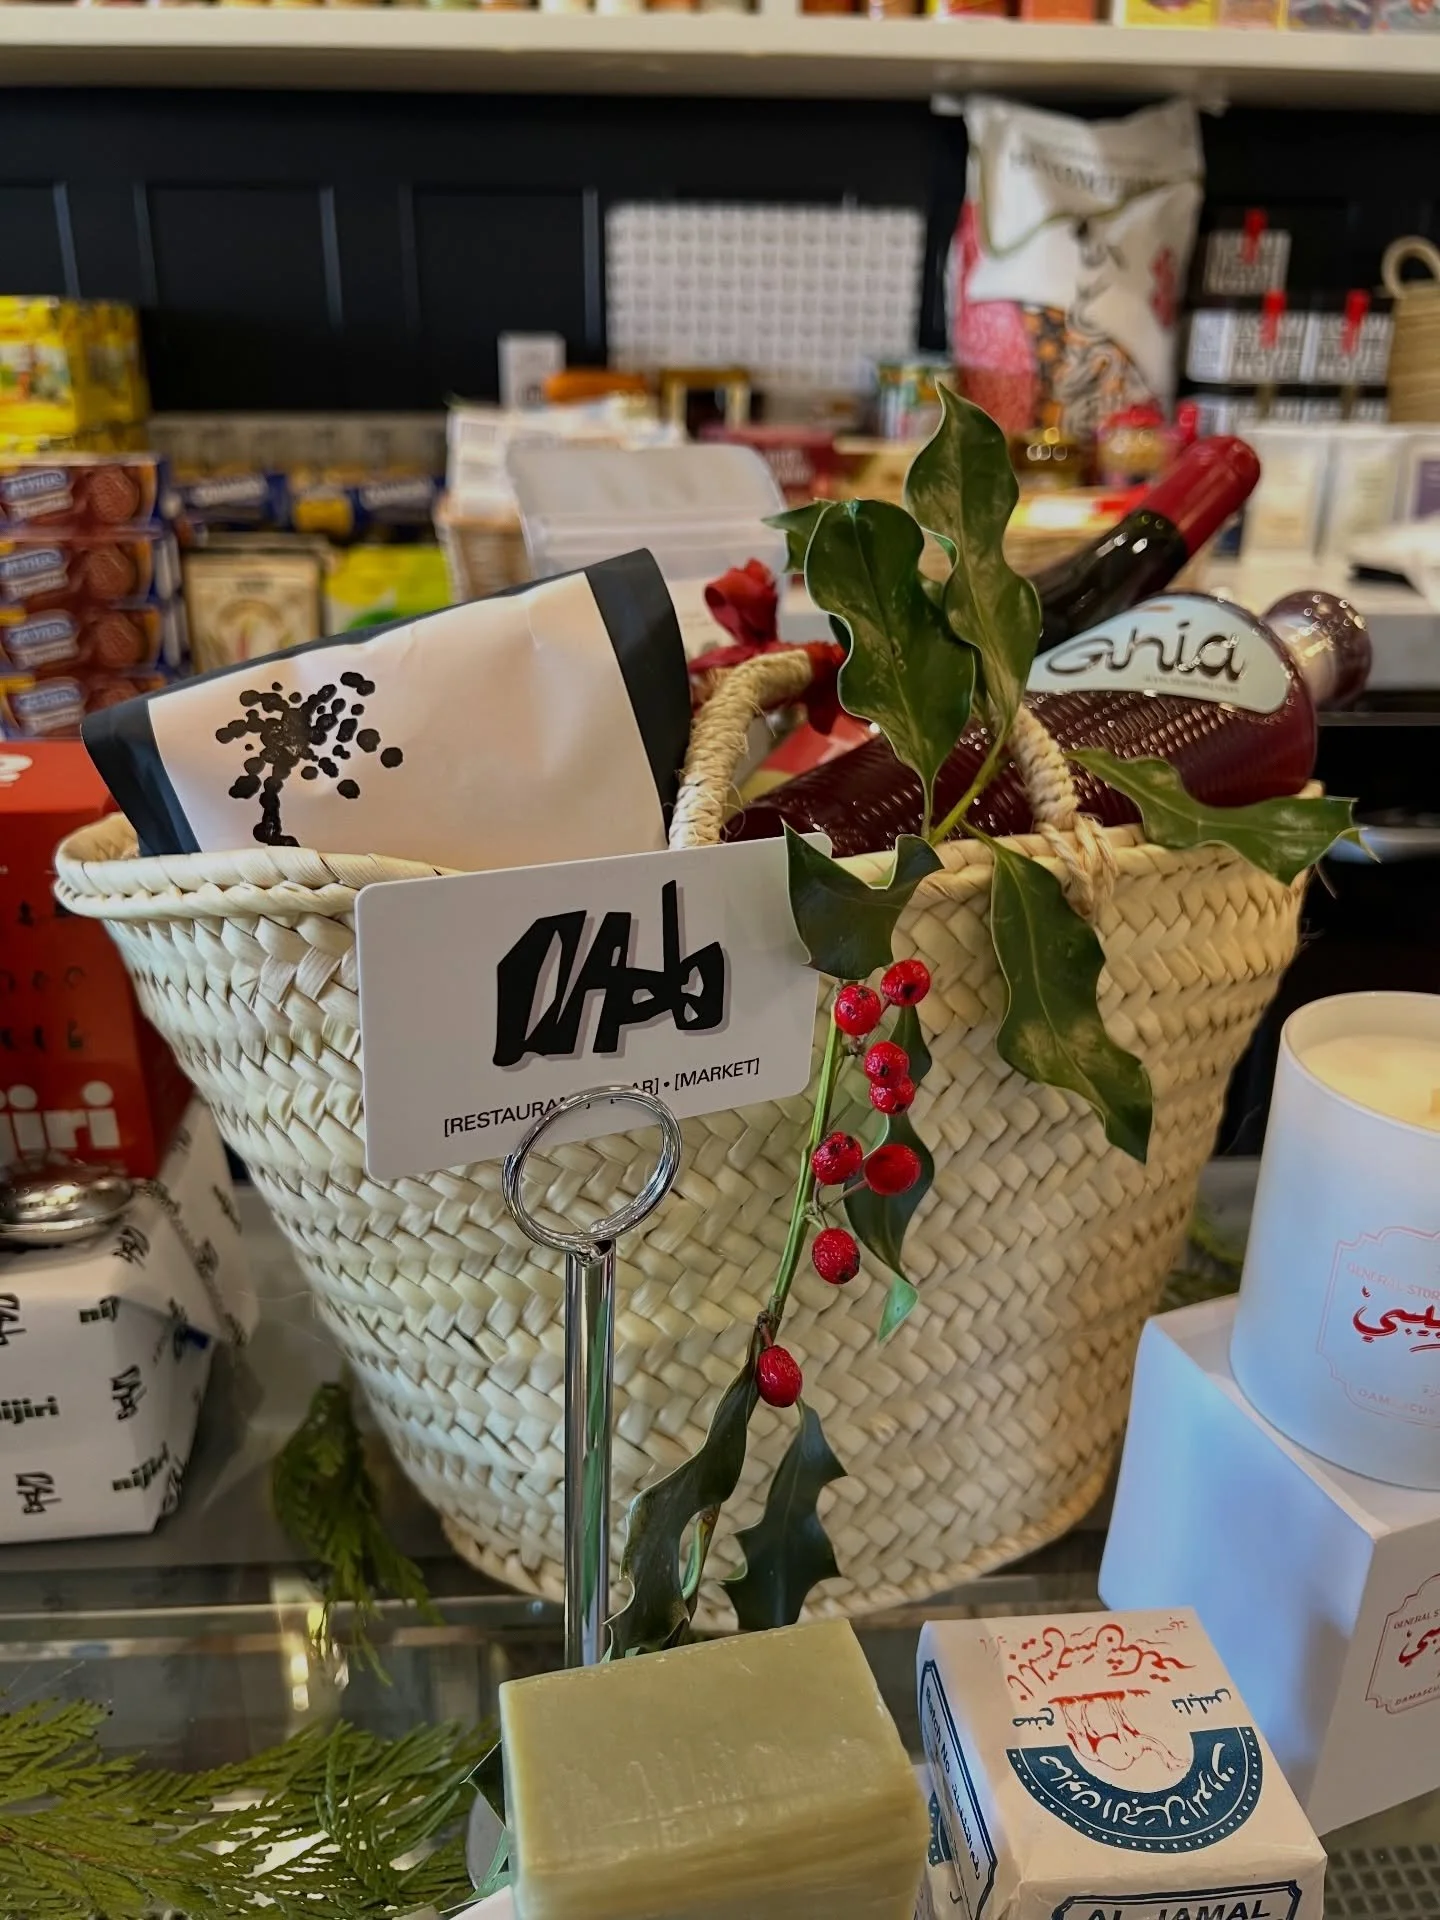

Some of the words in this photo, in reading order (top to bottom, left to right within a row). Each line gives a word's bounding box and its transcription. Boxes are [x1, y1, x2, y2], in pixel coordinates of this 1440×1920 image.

[1046, 620, 1247, 683] Ghia
[444, 1094, 590, 1138] [RESTAURA
[674, 1057, 761, 1092] [MARKET]
[0, 1396, 59, 1425] ijiri
[1393, 1612, 1431, 1630] GENERAL
[1012, 1706, 1056, 1731] صنع
[1171, 1687, 1232, 1716] نابلس
[1039, 1755, 1102, 1809] صابون
